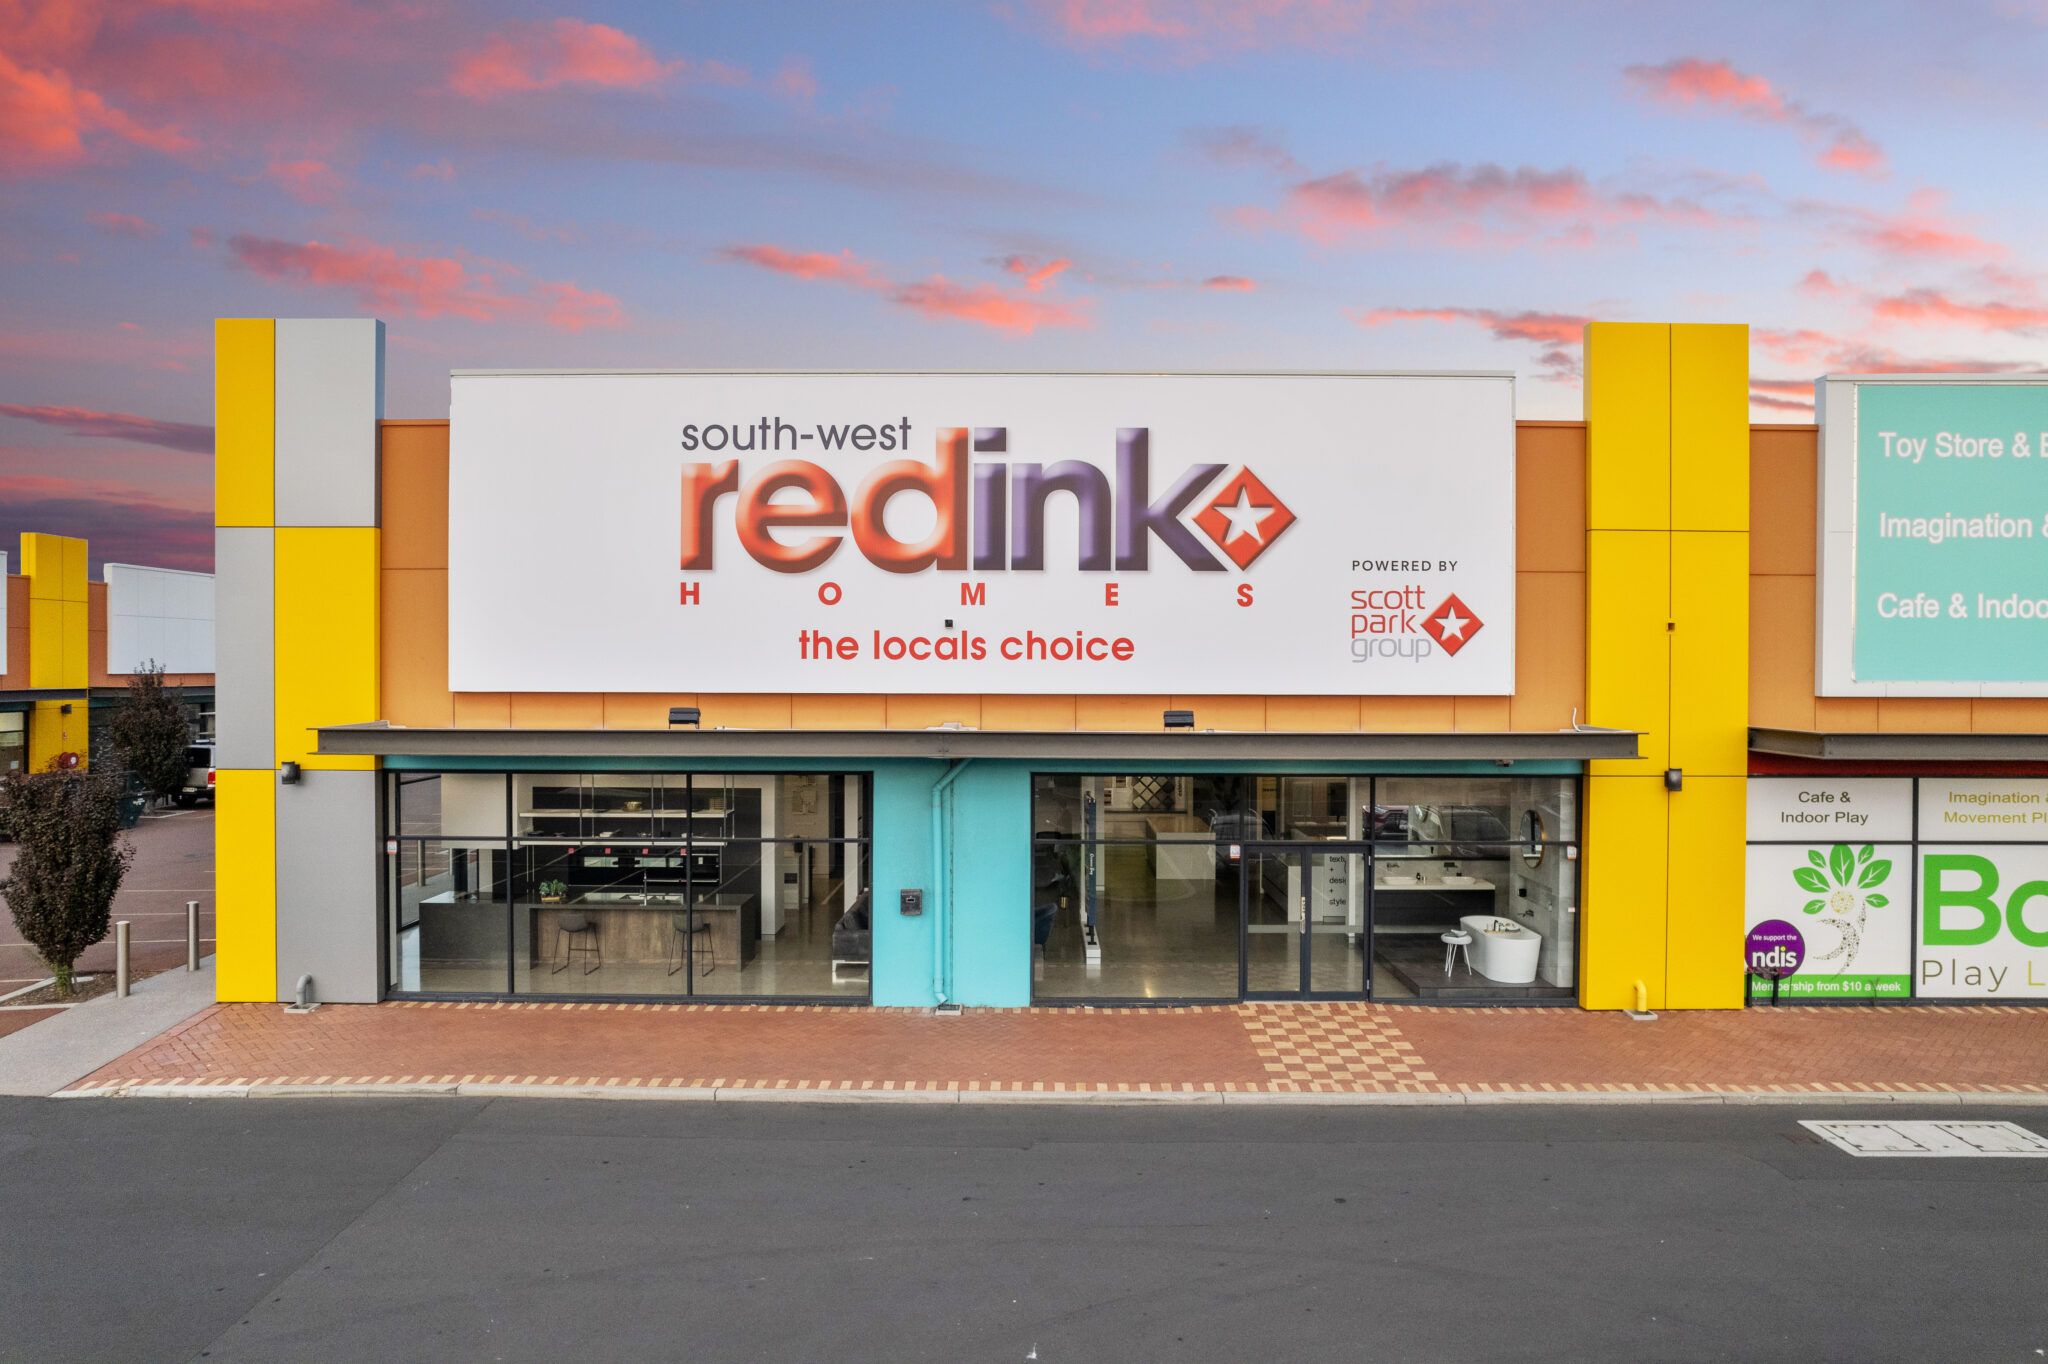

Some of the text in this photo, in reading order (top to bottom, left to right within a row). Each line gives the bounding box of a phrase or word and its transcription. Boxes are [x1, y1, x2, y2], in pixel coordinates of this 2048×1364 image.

[681, 416, 912, 451] south-west
[1878, 431, 1927, 464] Toy
[1935, 431, 2003, 458] Store
[2012, 431, 2031, 458] &
[680, 426, 1229, 574] redink
[1879, 511, 2033, 545] Imagination
[1351, 560, 1458, 572] POWERED BY
[1351, 585, 1426, 610] scott
[1877, 592, 1940, 618] Cafe
[1948, 592, 1968, 618] &
[1351, 609, 1417, 638] park
[799, 630, 1135, 661] the locals choice
[1351, 638, 1432, 664] group
[1798, 791, 1852, 803] Cafe &
[1949, 791, 2040, 806] Imagination
[1781, 811, 1869, 827] Indoor Play
[1944, 811, 2027, 824] Movement
[1752, 946, 1797, 967] ndis
[1816, 980, 1840, 992] from
[1842, 980, 1862, 993] $10
[1864, 983, 1872, 992] a
[1922, 958, 2008, 993] Play
